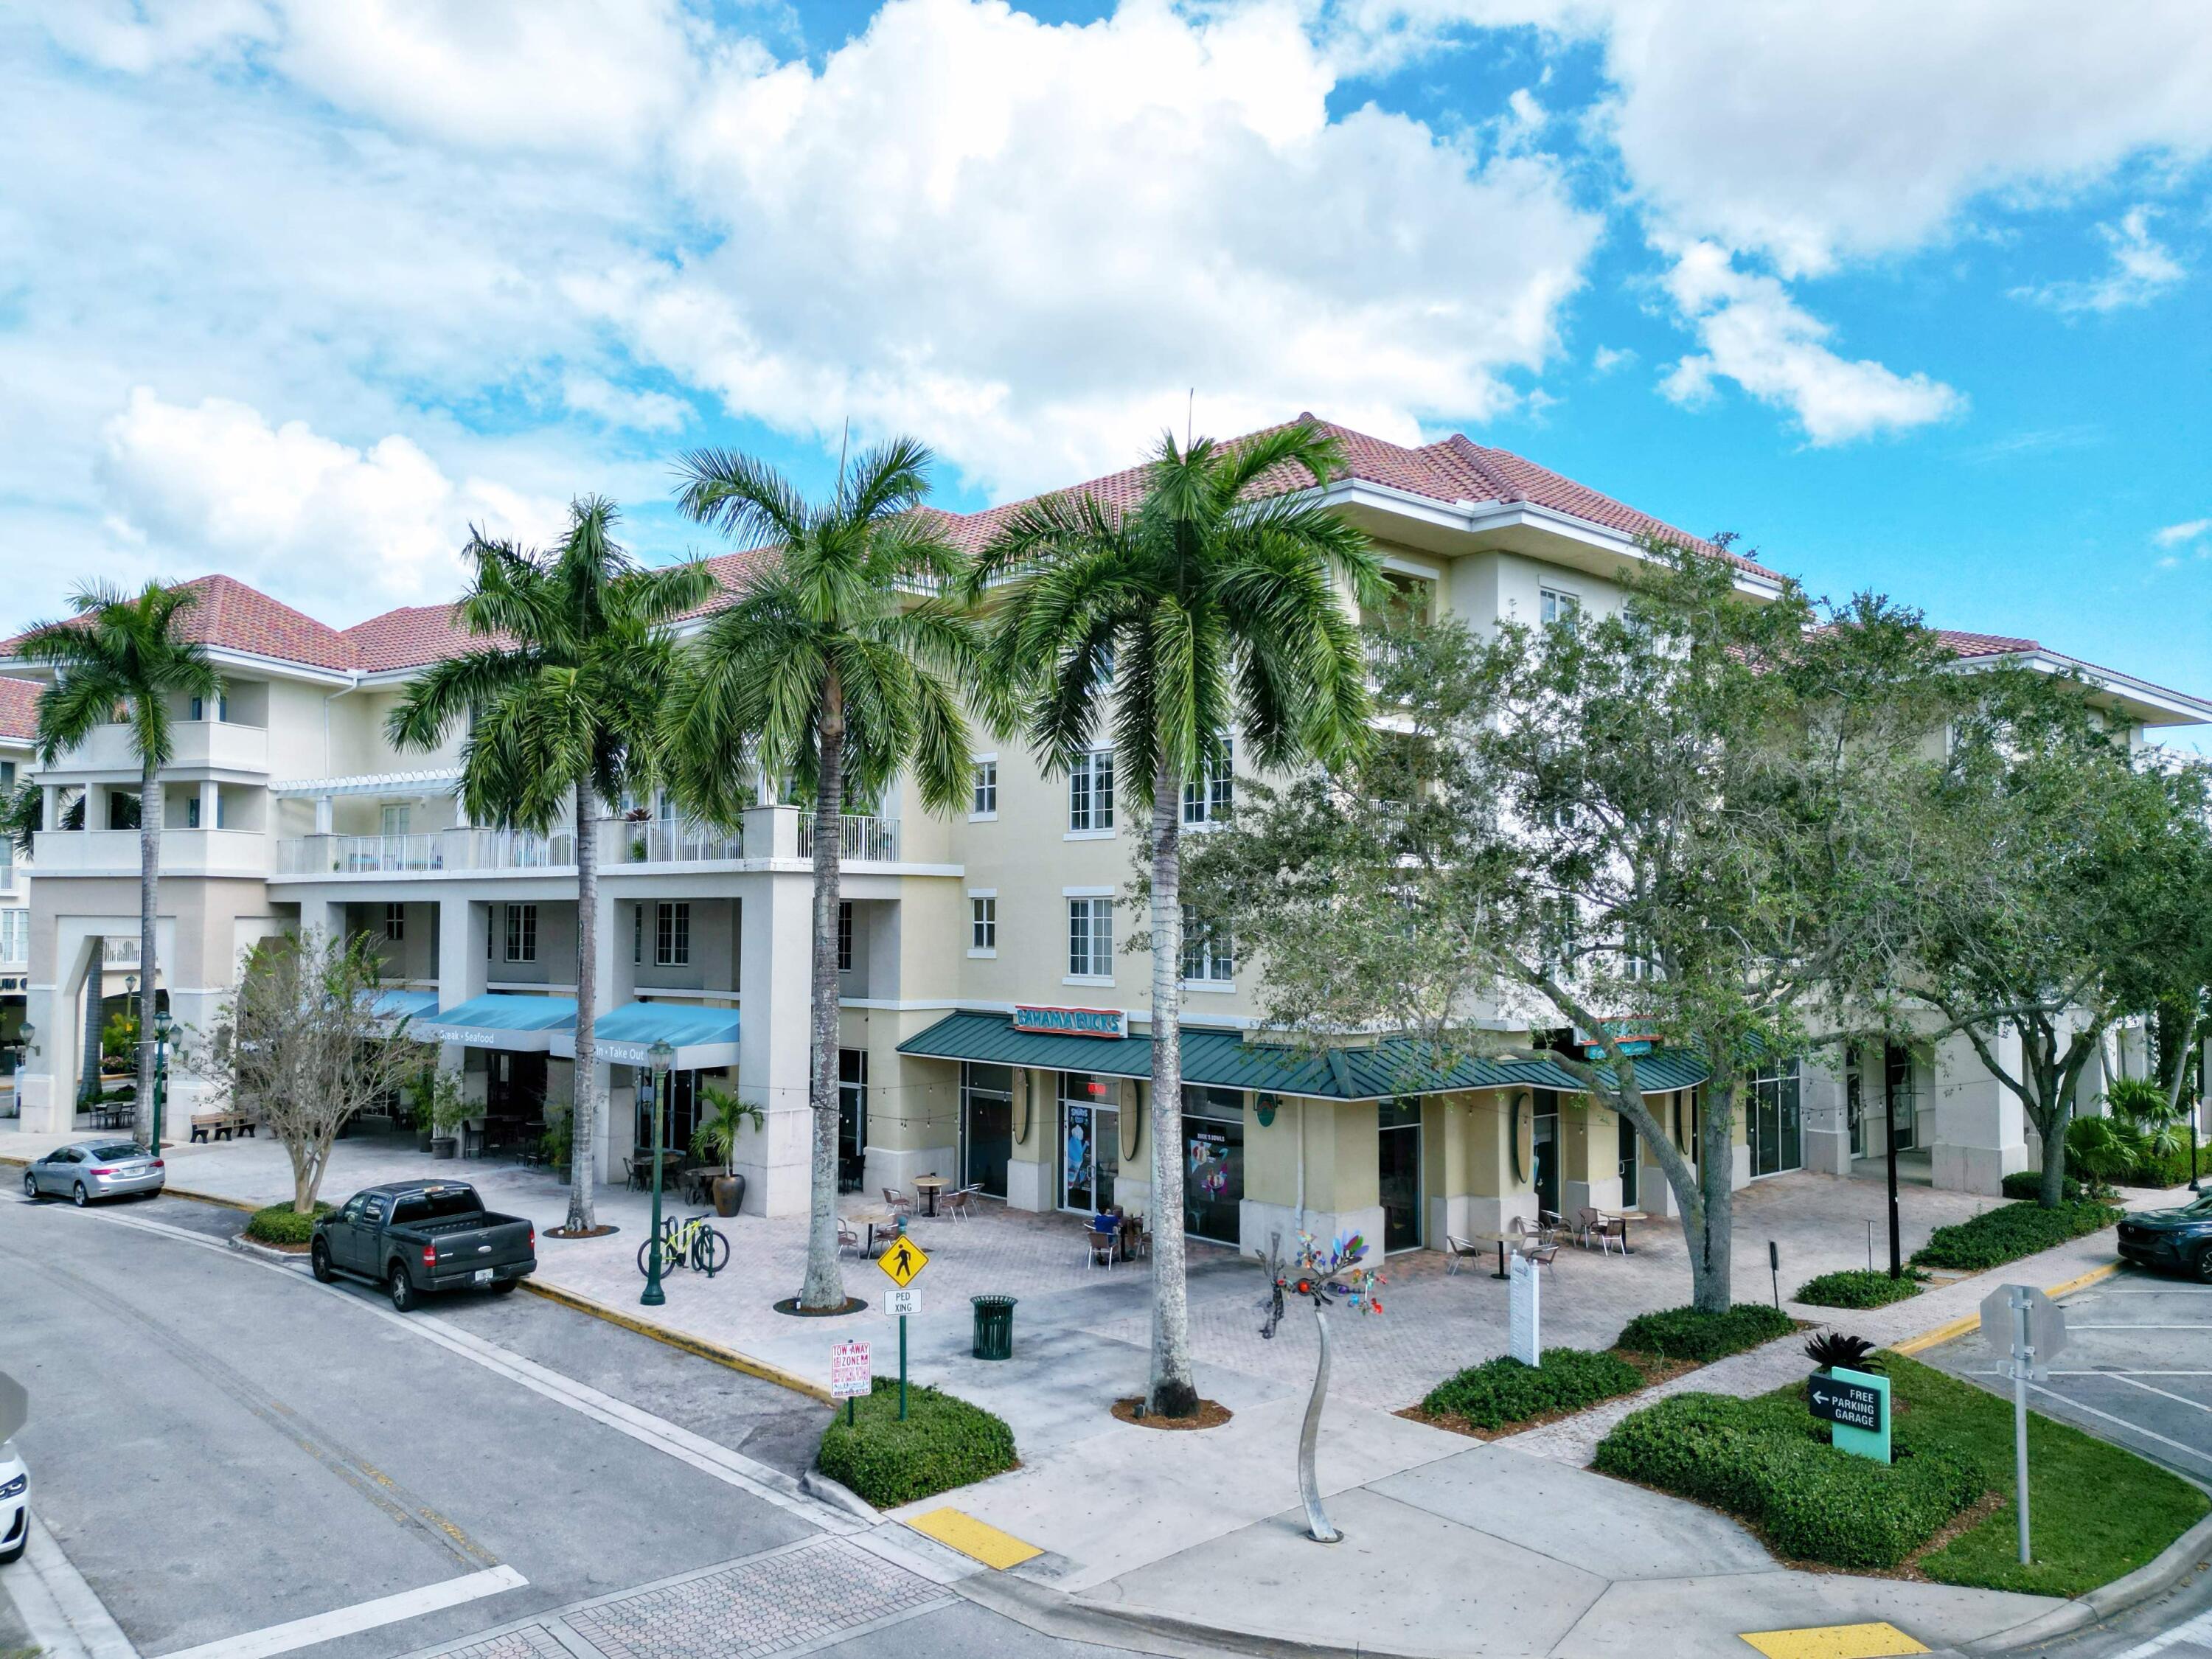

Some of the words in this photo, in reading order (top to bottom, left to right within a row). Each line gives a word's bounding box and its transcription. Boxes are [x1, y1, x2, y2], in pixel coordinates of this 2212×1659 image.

[1017, 1009, 1074, 1028] BAHAMA
[440, 1030, 459, 1040] Steak
[465, 1032, 494, 1044] Seafood
[610, 1046, 627, 1060] Take
[630, 1048, 644, 1061] Out
[896, 1292, 911, 1301] PED
[895, 1303, 912, 1312] XING
[834, 1346, 847, 1356] TOW
[849, 1344, 868, 1354] AWAY
[842, 1355, 860, 1366] ZONE
[1850, 1389, 1874, 1403] FREE
[1832, 1396, 1874, 1415] PARKING
[1835, 1409, 1874, 1427] GARAGE
